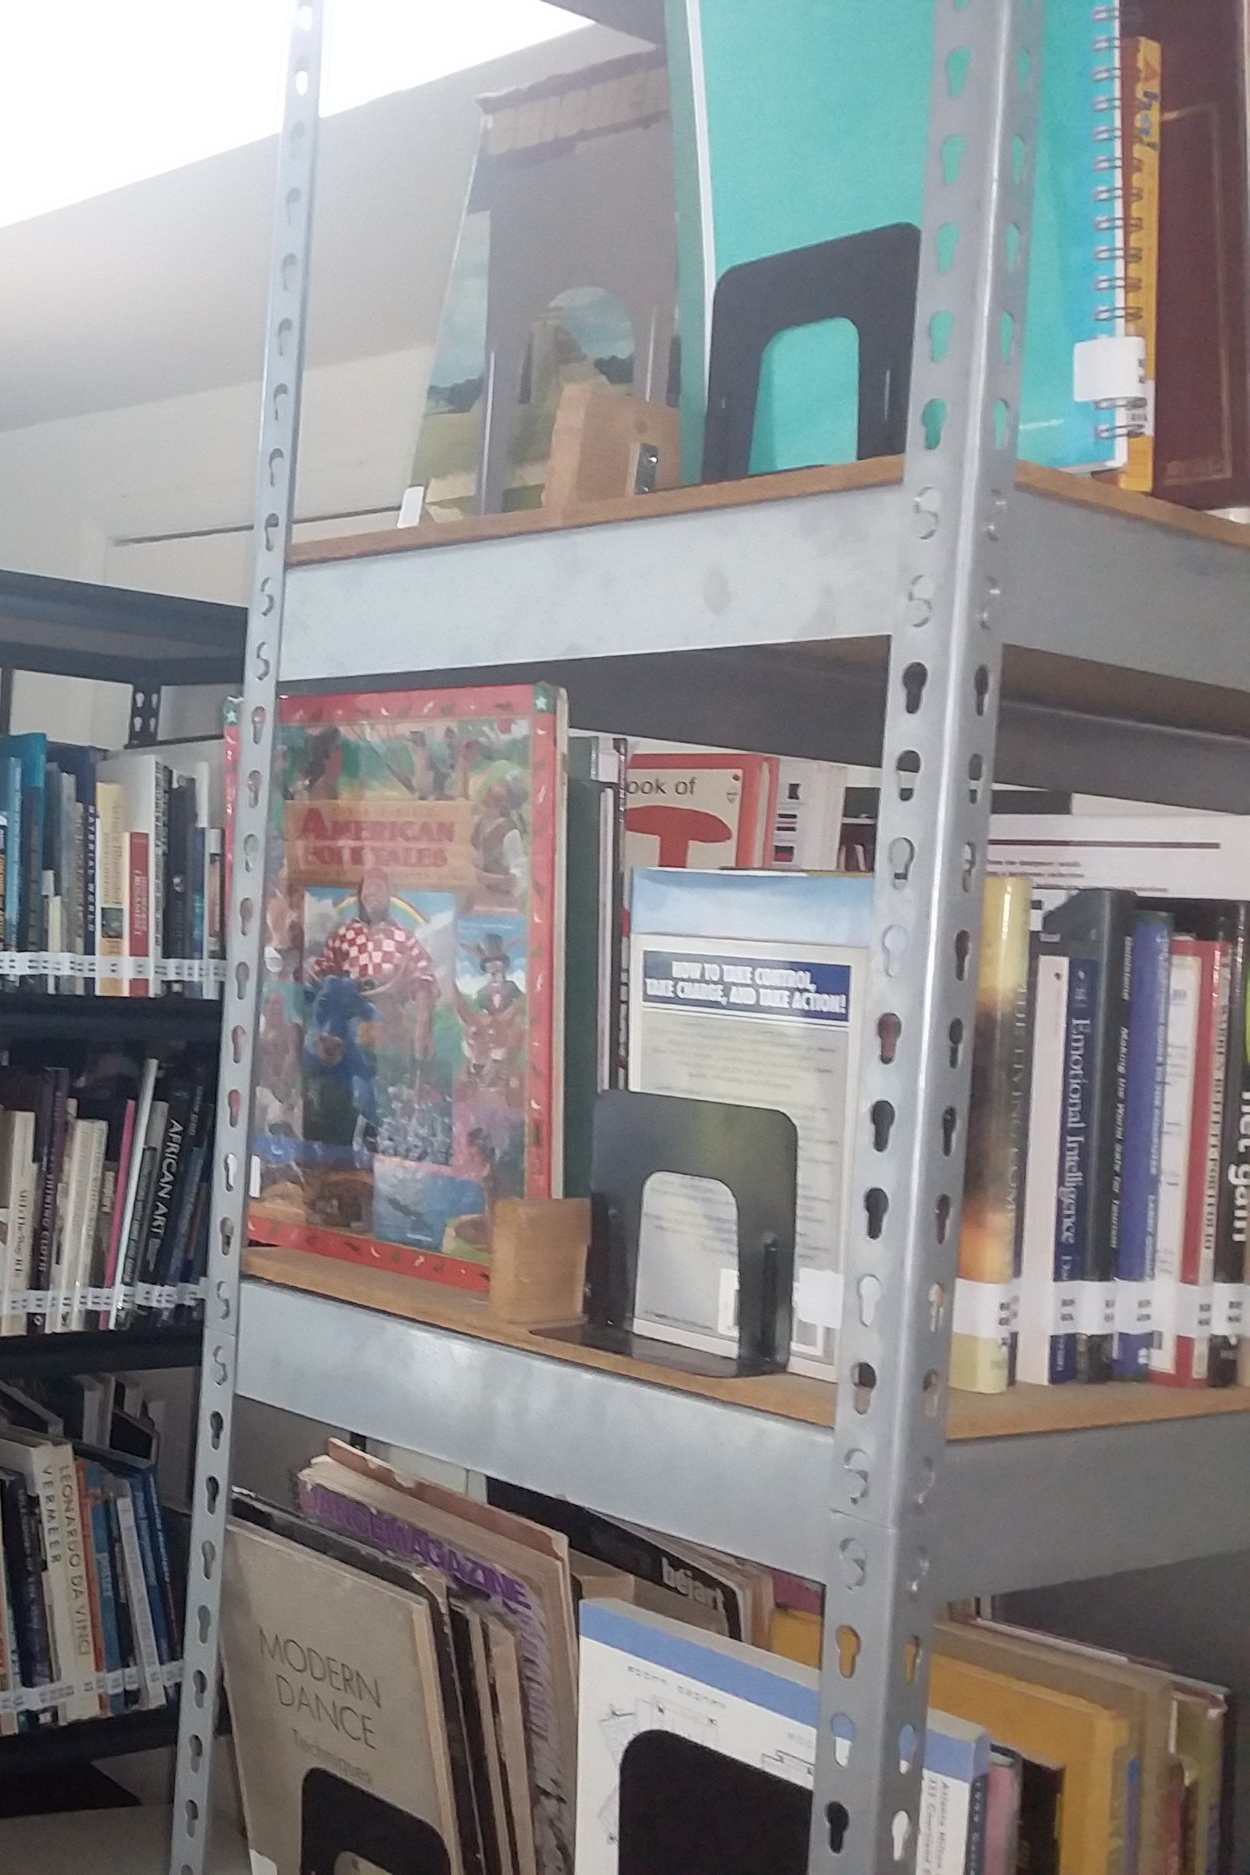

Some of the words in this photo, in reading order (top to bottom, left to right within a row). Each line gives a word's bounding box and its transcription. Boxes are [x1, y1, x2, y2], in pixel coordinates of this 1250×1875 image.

[627, 778, 667, 795] ook
[675, 776, 698, 795] of
[301, 807, 455, 842] AMERICAN
[671, 960, 703, 980] HOW
[704, 963, 721, 981] TO
[722, 965, 754, 984] TAKE
[645, 978, 674, 998] TAKE
[729, 986, 757, 1005] AND
[759, 988, 791, 1008] TAKE
[791, 990, 846, 1014] ACTION!
[1115, 1026, 1130, 1074] Making
[1065, 1017, 1092, 1129] Emotional
[1117, 1076, 1127, 1099] the
[1115, 1102, 1125, 1139] World
[156, 1118, 184, 1199] AFRICAN
[1058, 1134, 1086, 1245] Intelligence
[1112, 1175, 1122, 1193] for
[149, 1201, 170, 1236] ART
[42, 1465, 61, 1565] VERMEER
[59, 1464, 81, 1568] LEONARDO
[70, 1575, 85, 1599] DA
[75, 1600, 91, 1657] VINCI
[258, 1628, 382, 1709] MODERN
[276, 1676, 378, 1750] DANCE
